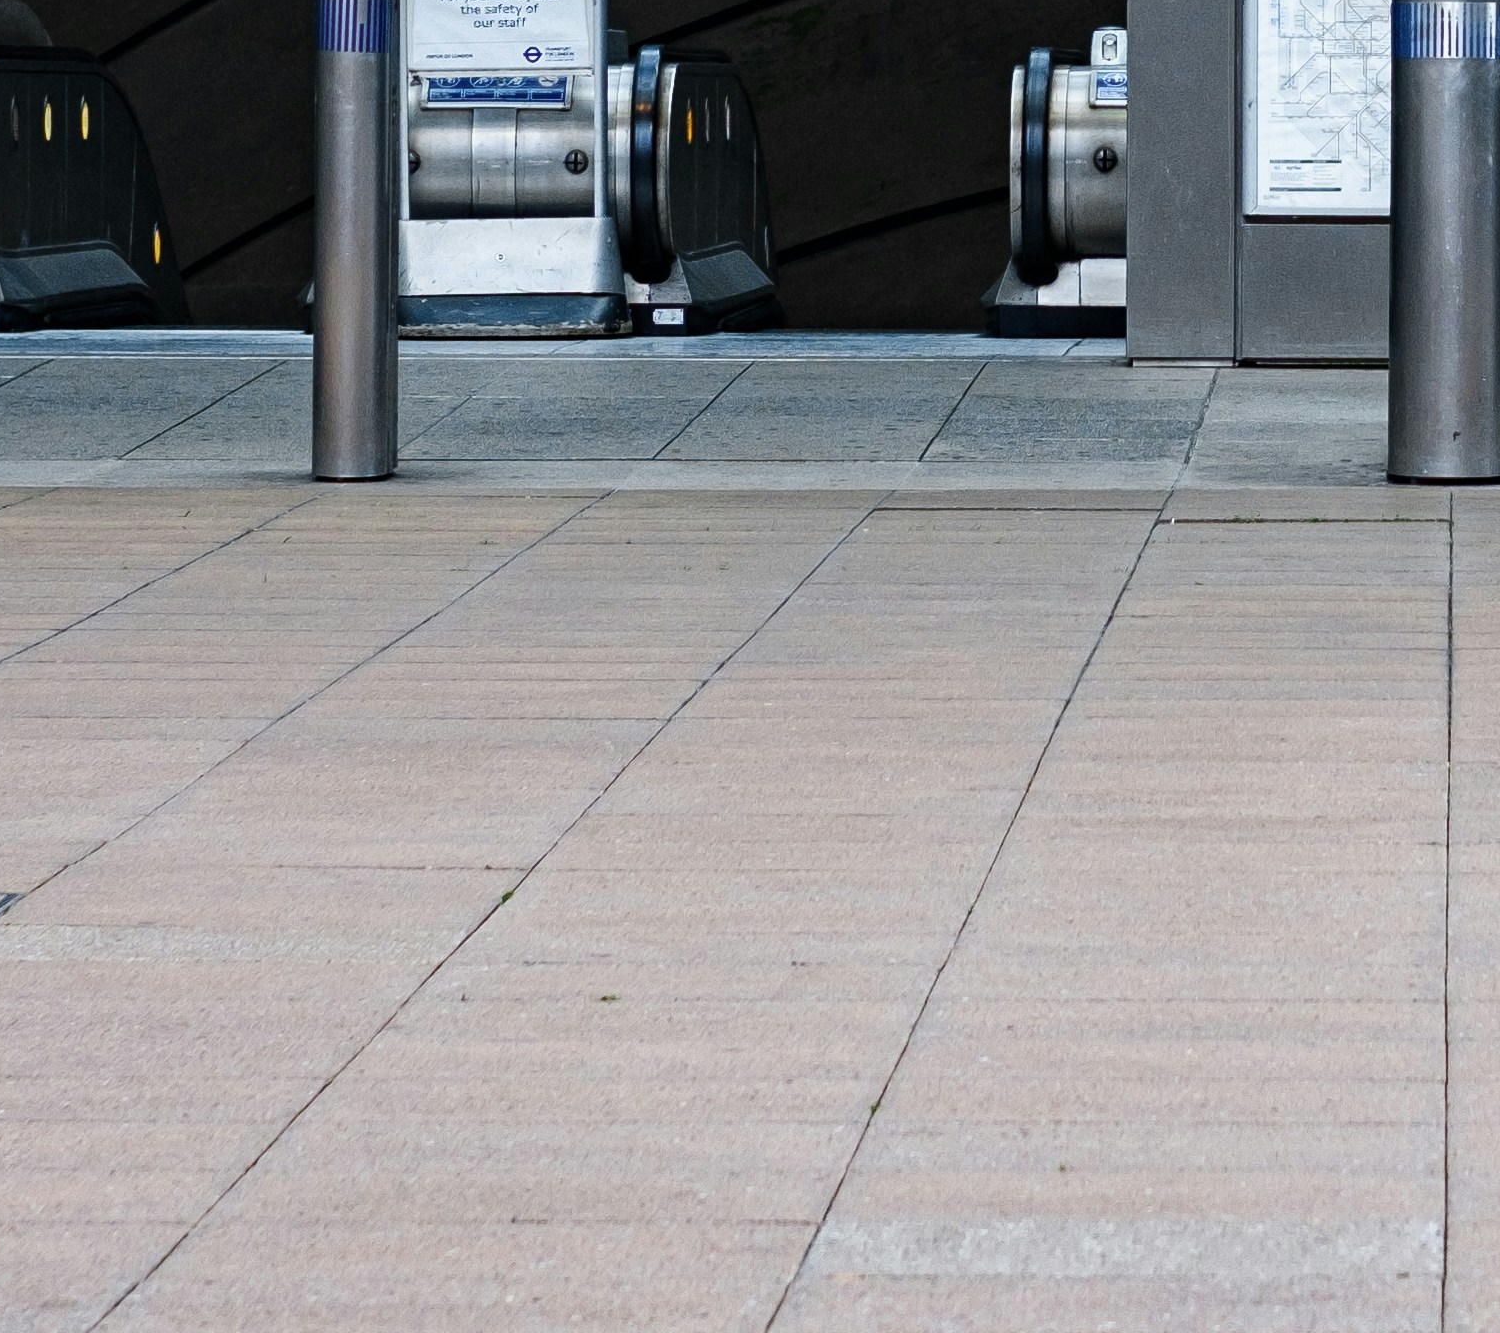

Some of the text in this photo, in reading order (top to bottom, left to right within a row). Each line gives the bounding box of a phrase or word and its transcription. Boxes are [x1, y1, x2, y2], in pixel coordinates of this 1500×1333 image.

[460, 3, 540, 16] the safety of
[473, 17, 527, 28] our staff
